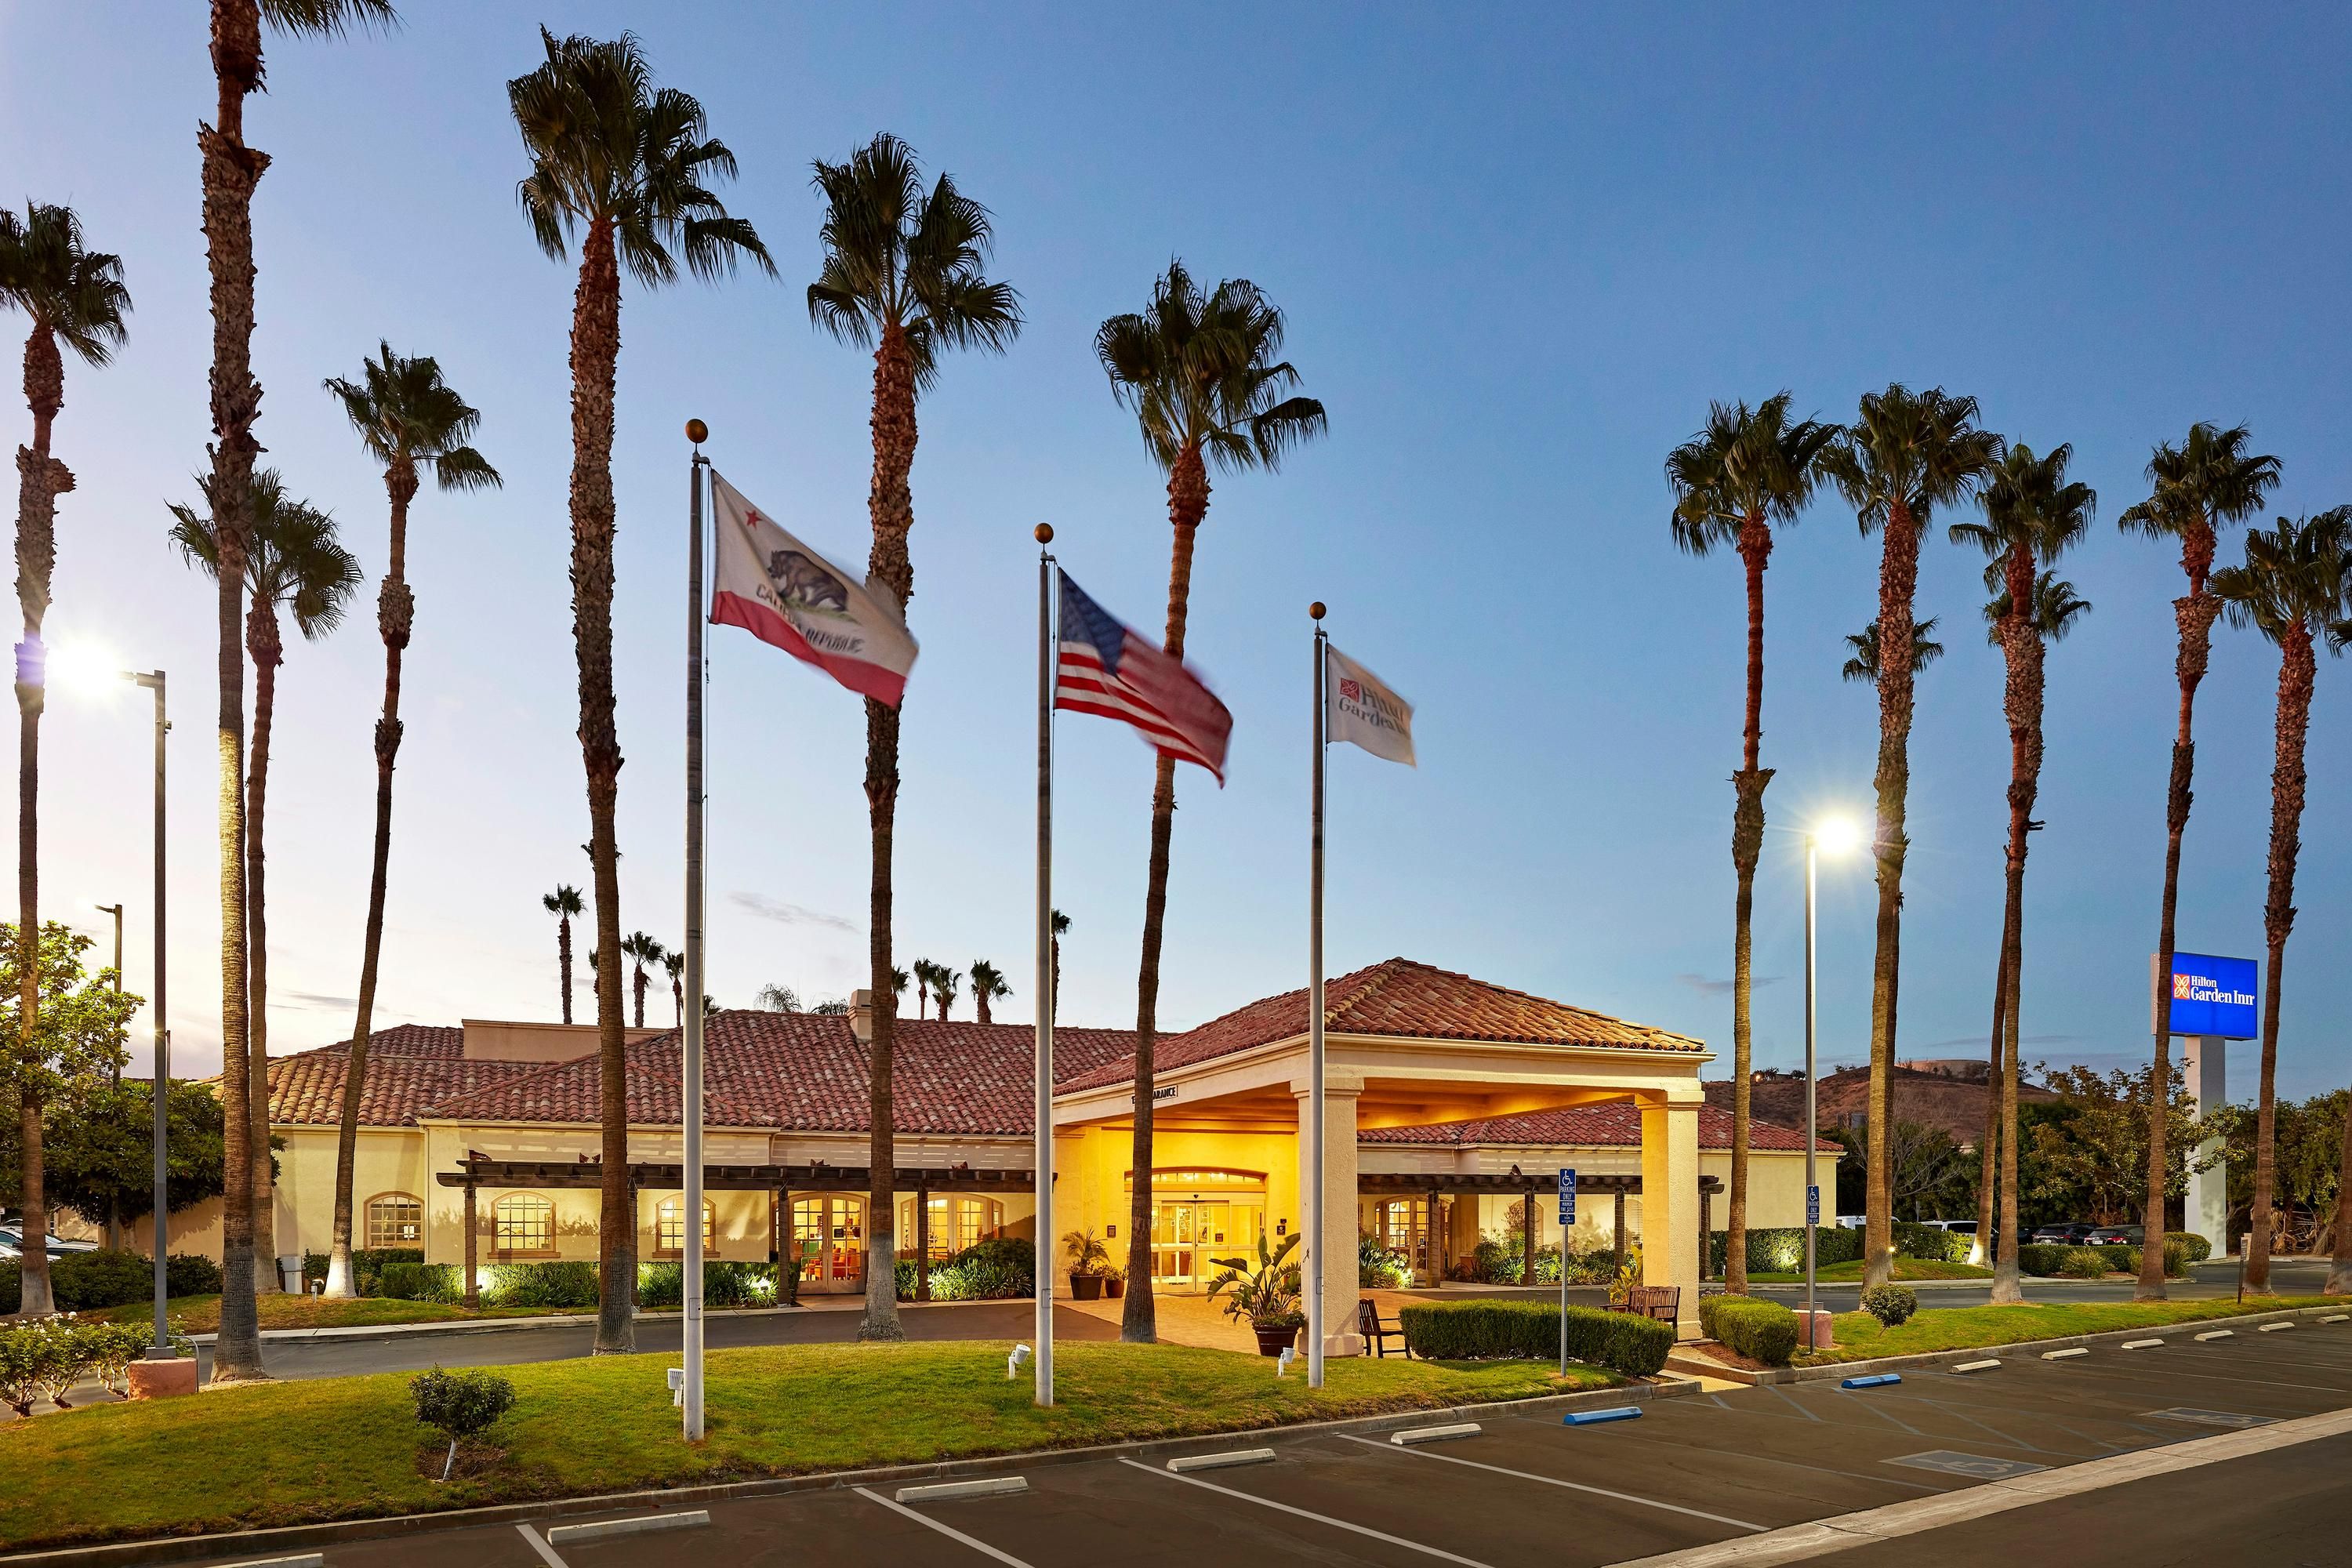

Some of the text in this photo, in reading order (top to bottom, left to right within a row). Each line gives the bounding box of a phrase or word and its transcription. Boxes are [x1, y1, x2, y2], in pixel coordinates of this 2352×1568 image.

[1339, 697, 1396, 731] Garden
[2191, 975, 2217, 988] Hilton
[2190, 986, 2254, 1005] Garden Inn
[1153, 1087, 1176, 1100] ARANCE
